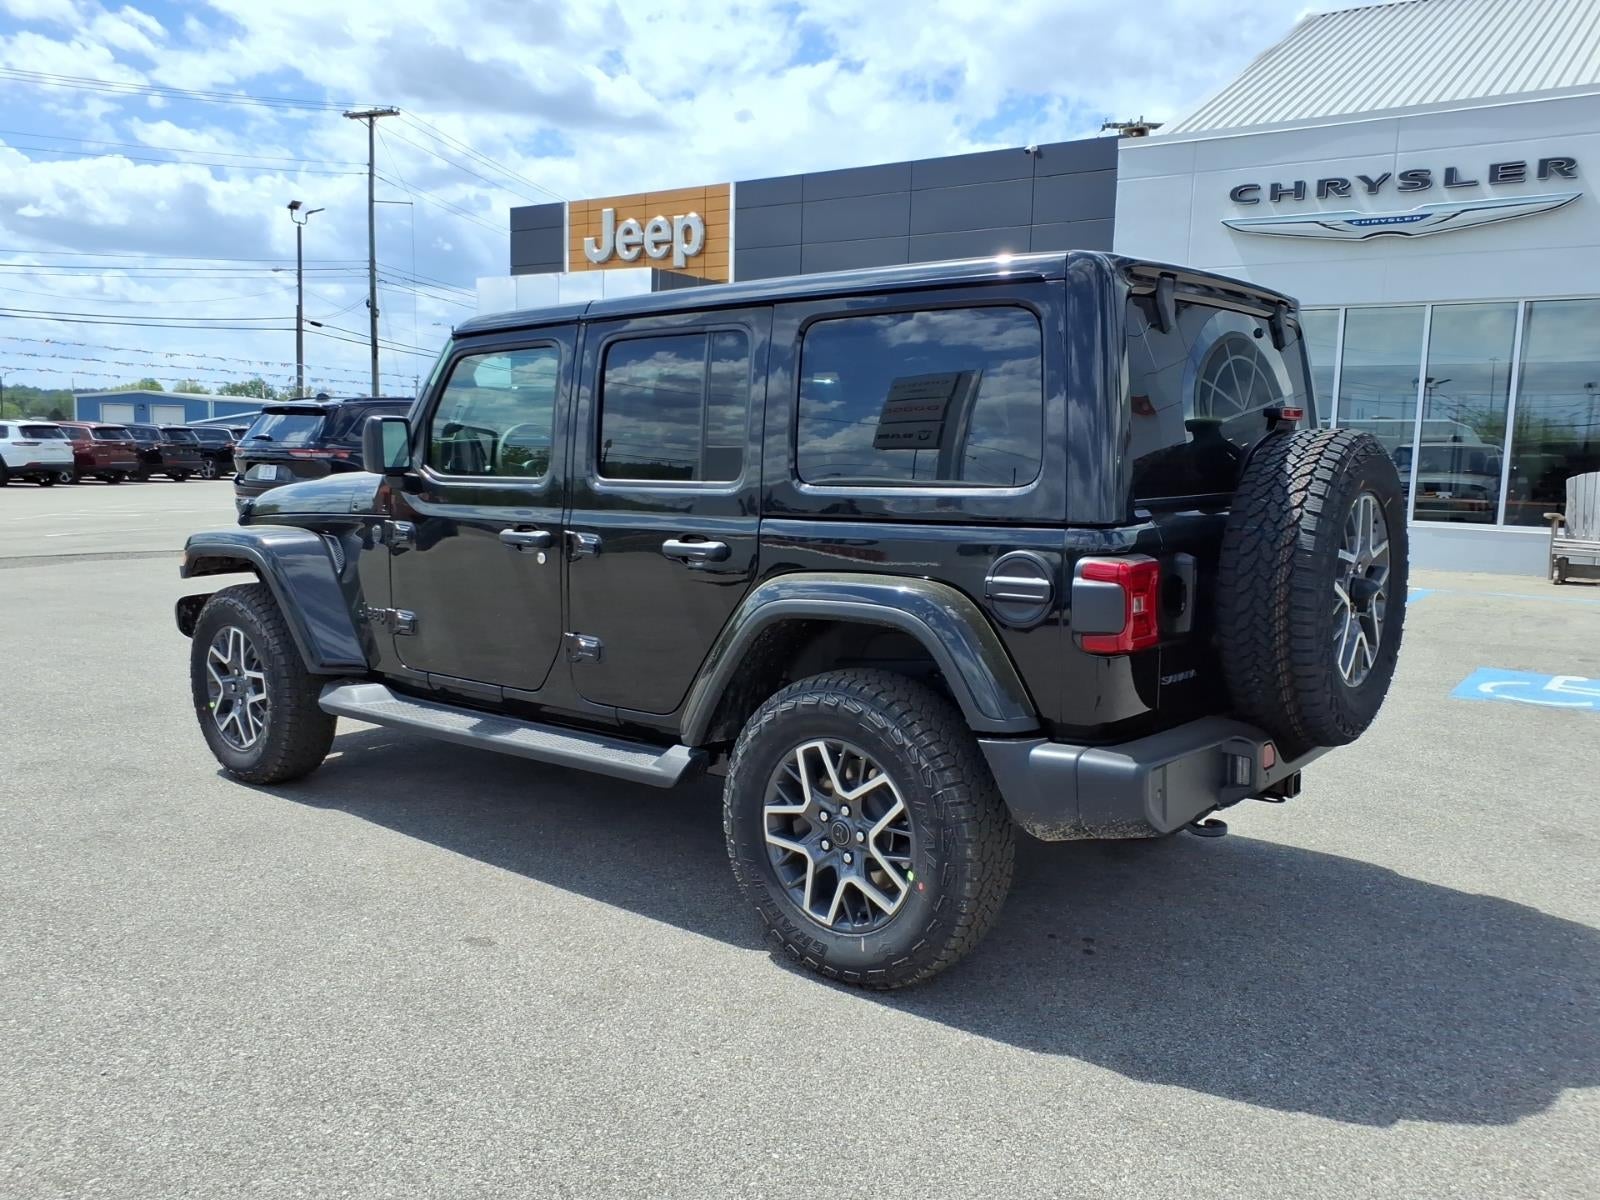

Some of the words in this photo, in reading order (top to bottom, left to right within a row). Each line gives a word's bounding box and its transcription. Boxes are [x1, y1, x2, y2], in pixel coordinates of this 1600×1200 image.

[1229, 156, 1579, 205] CHRYSLER
[584, 207, 705, 269] Jeep
[1352, 215, 1421, 225] CHRYSLER
